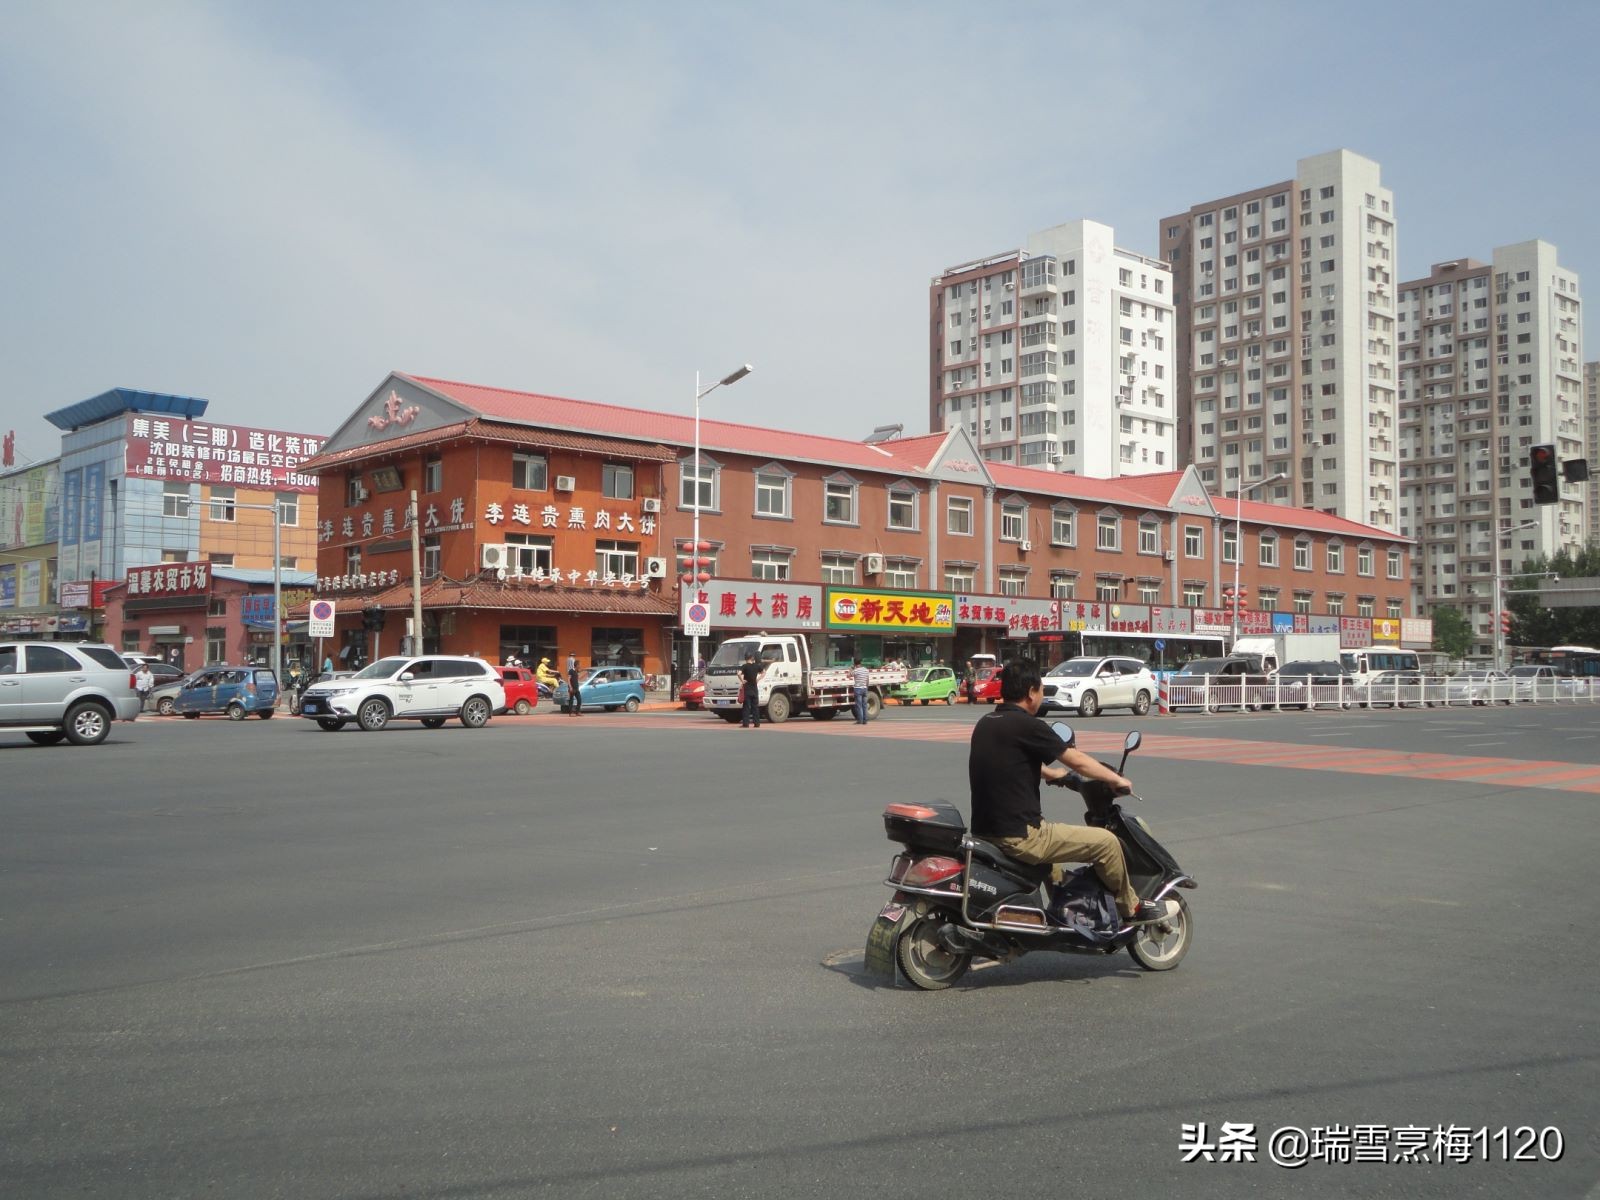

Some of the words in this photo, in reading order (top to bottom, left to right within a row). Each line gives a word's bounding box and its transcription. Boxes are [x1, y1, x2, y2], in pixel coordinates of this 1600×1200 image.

[132, 418, 325, 456] 集美（三期）造化装饰
[149, 441, 310, 469] 沈阳装修市场最后空白
[484, 502, 657, 536] 李连贵熏肉大饼
[127, 565, 206, 594] 温馨农贸市场
[496, 565, 651, 589] 百年传承中华老字号
[858, 598, 935, 625] 新天地
[958, 604, 1006, 622] 农贸市场
